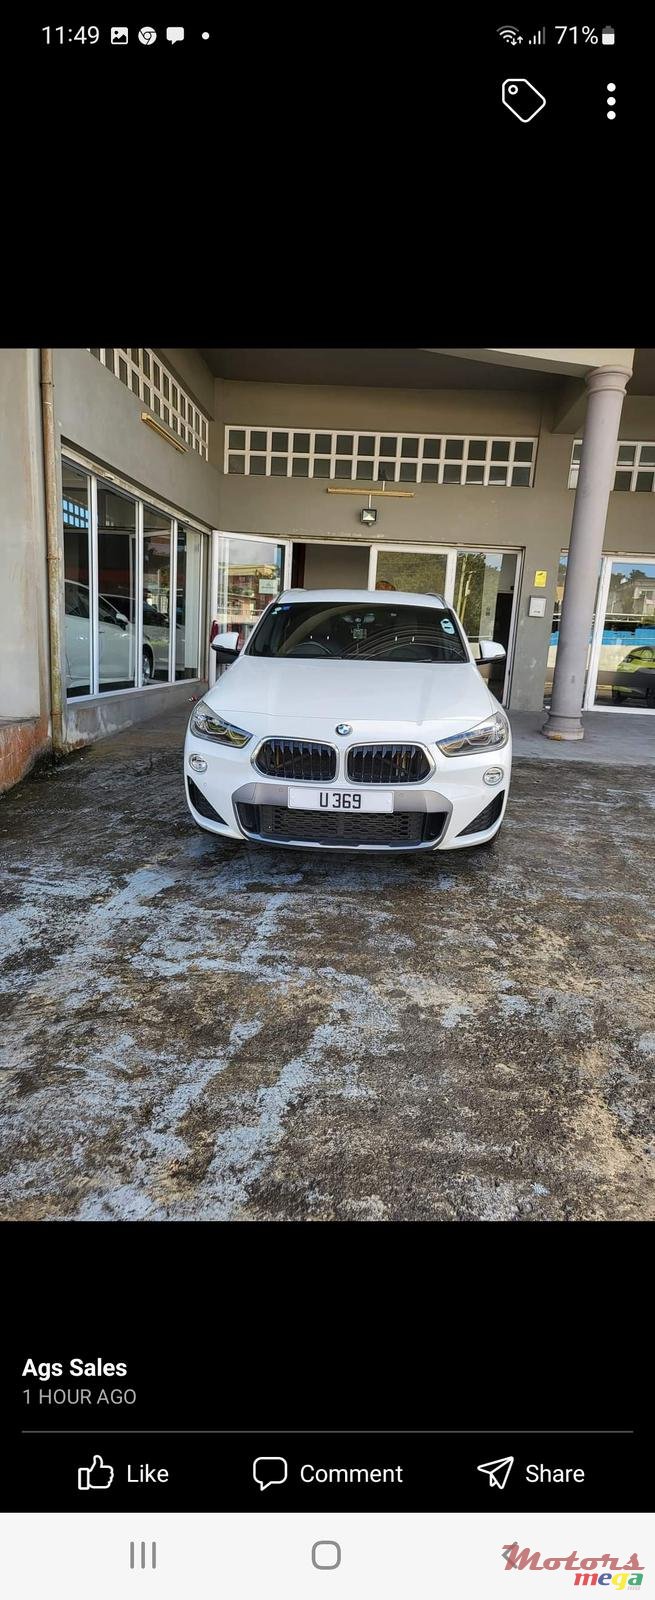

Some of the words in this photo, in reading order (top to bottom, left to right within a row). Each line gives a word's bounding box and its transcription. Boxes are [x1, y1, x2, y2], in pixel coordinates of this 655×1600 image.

[41, 26, 100, 45] 11:49
[554, 26, 599, 45] 71%
[319, 792, 329, 808] U
[332, 793, 362, 809] 369
[21, 1358, 63, 1381] Ags
[69, 1358, 128, 1377] Sales
[23, 1389, 31, 1405] 1
[39, 1389, 92, 1405] HOUR
[96, 1389, 137, 1405] AGO
[127, 1464, 169, 1483] Like
[300, 1464, 404, 1483] Comment
[525, 1464, 585, 1483] Share
